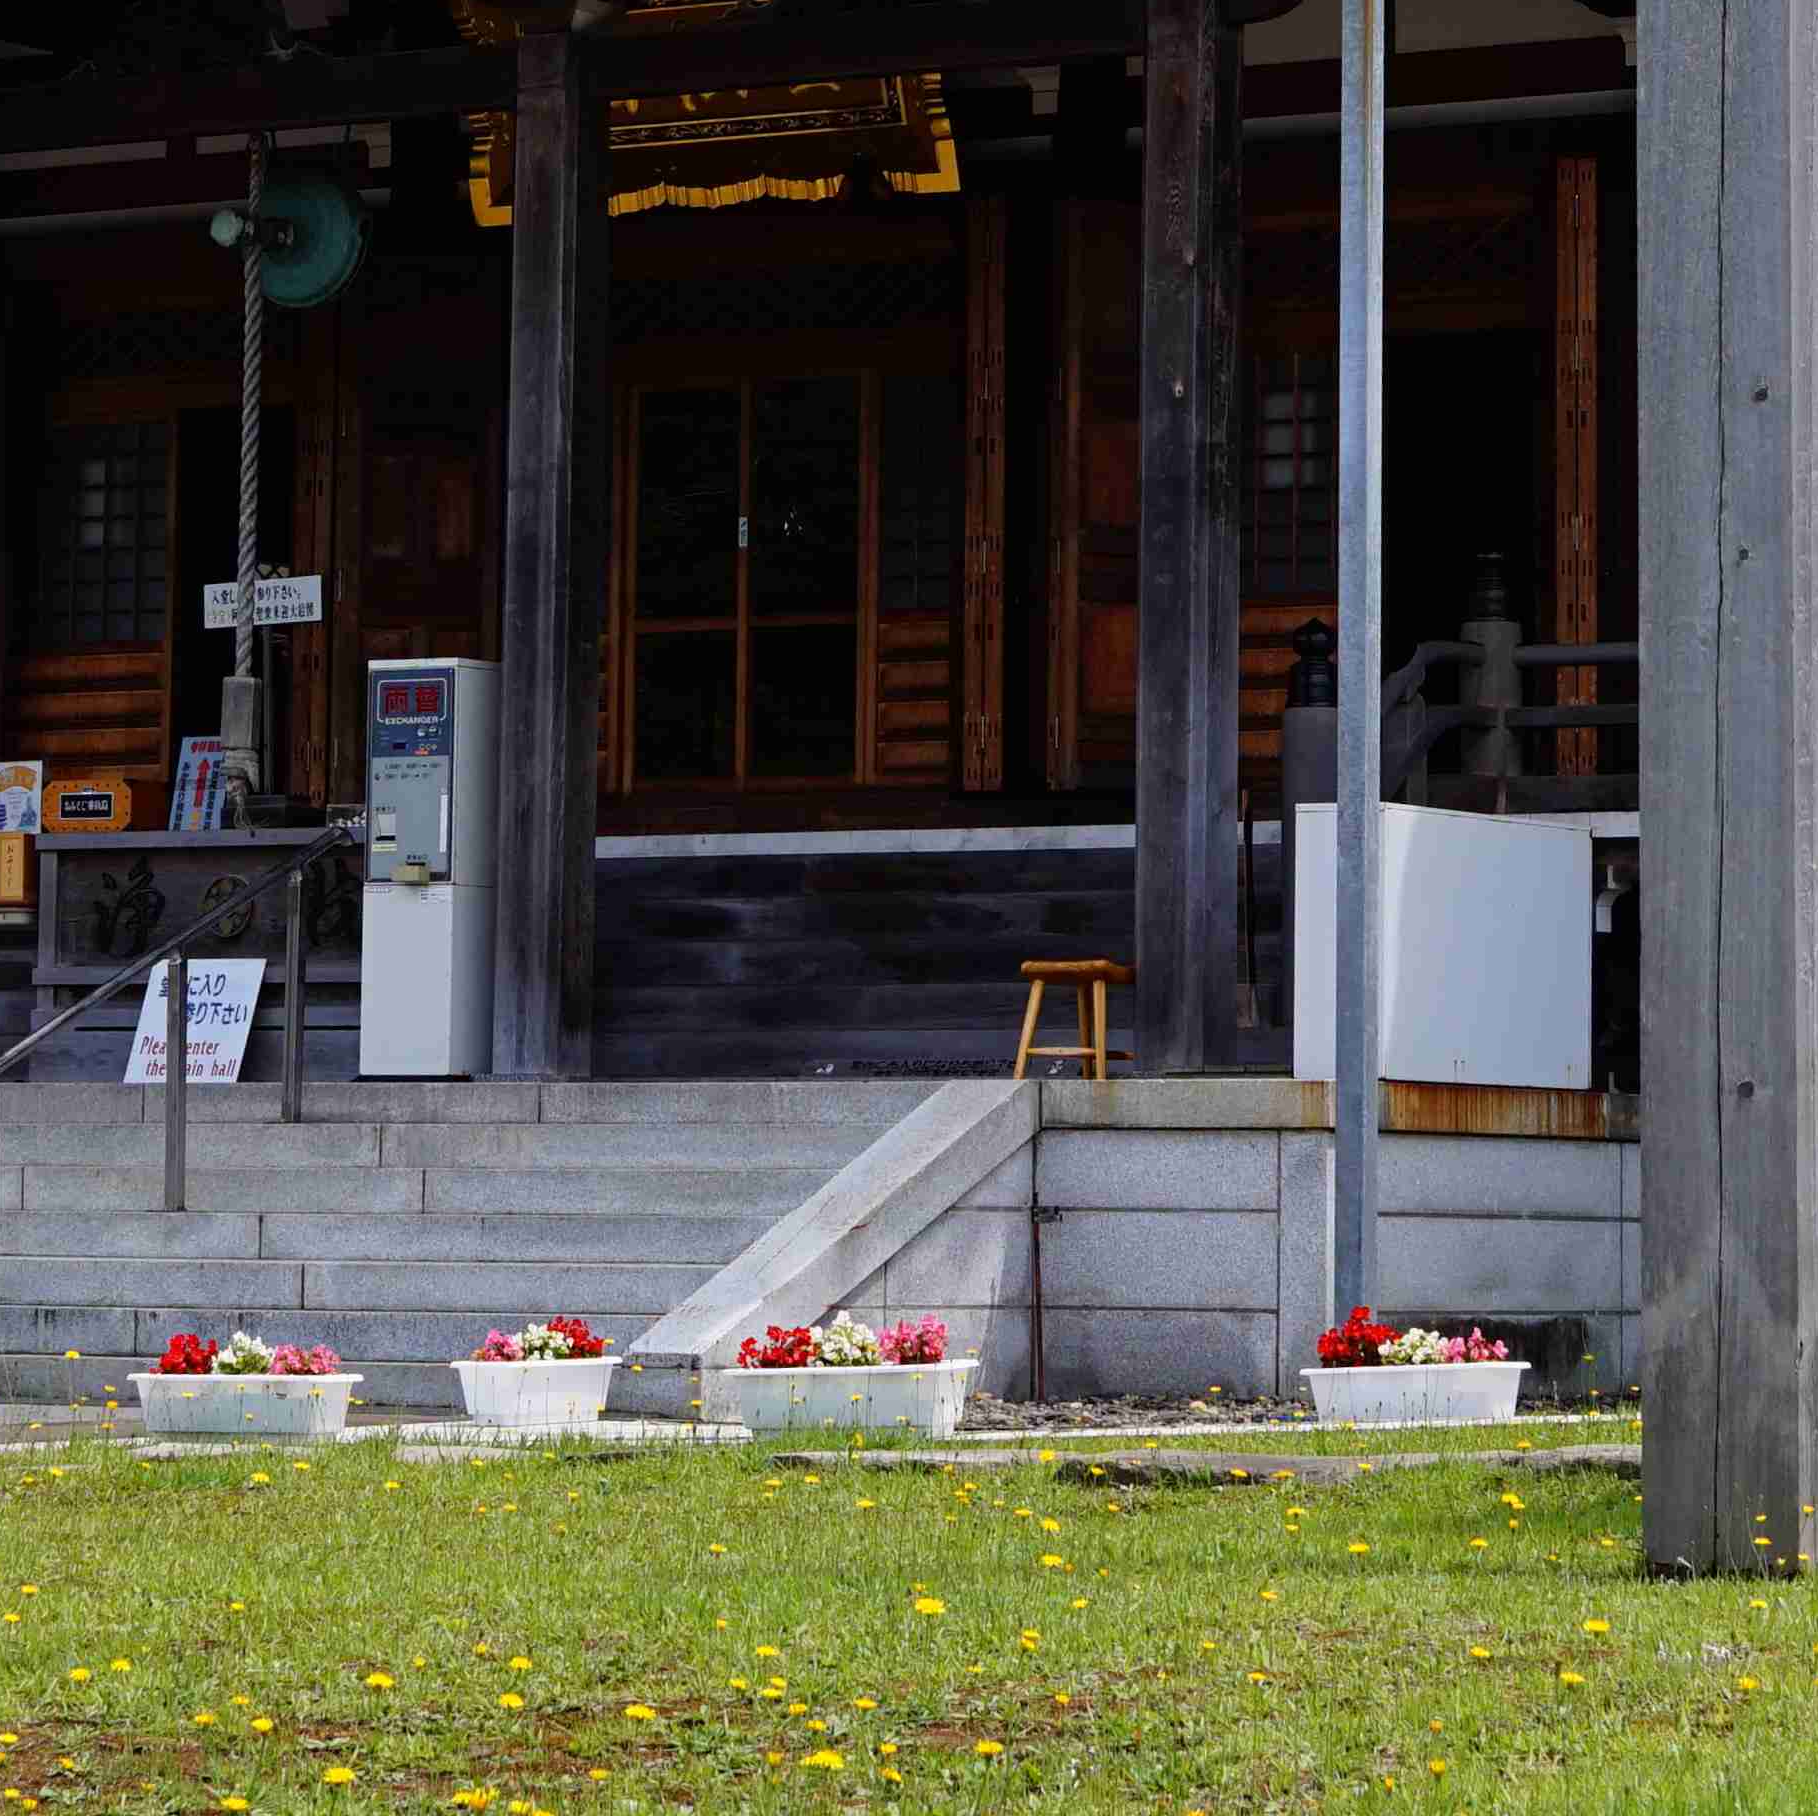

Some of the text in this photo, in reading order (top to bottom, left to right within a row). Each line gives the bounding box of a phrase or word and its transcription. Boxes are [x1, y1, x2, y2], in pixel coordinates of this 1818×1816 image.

[385, 715, 439, 725] EXCHANGER
[158, 973, 227, 999] 堂に入り
[184, 1001, 248, 1025] 参り下さい
[140, 1035, 221, 1055] Plea enter
[146, 1059, 237, 1077] the ain hall
